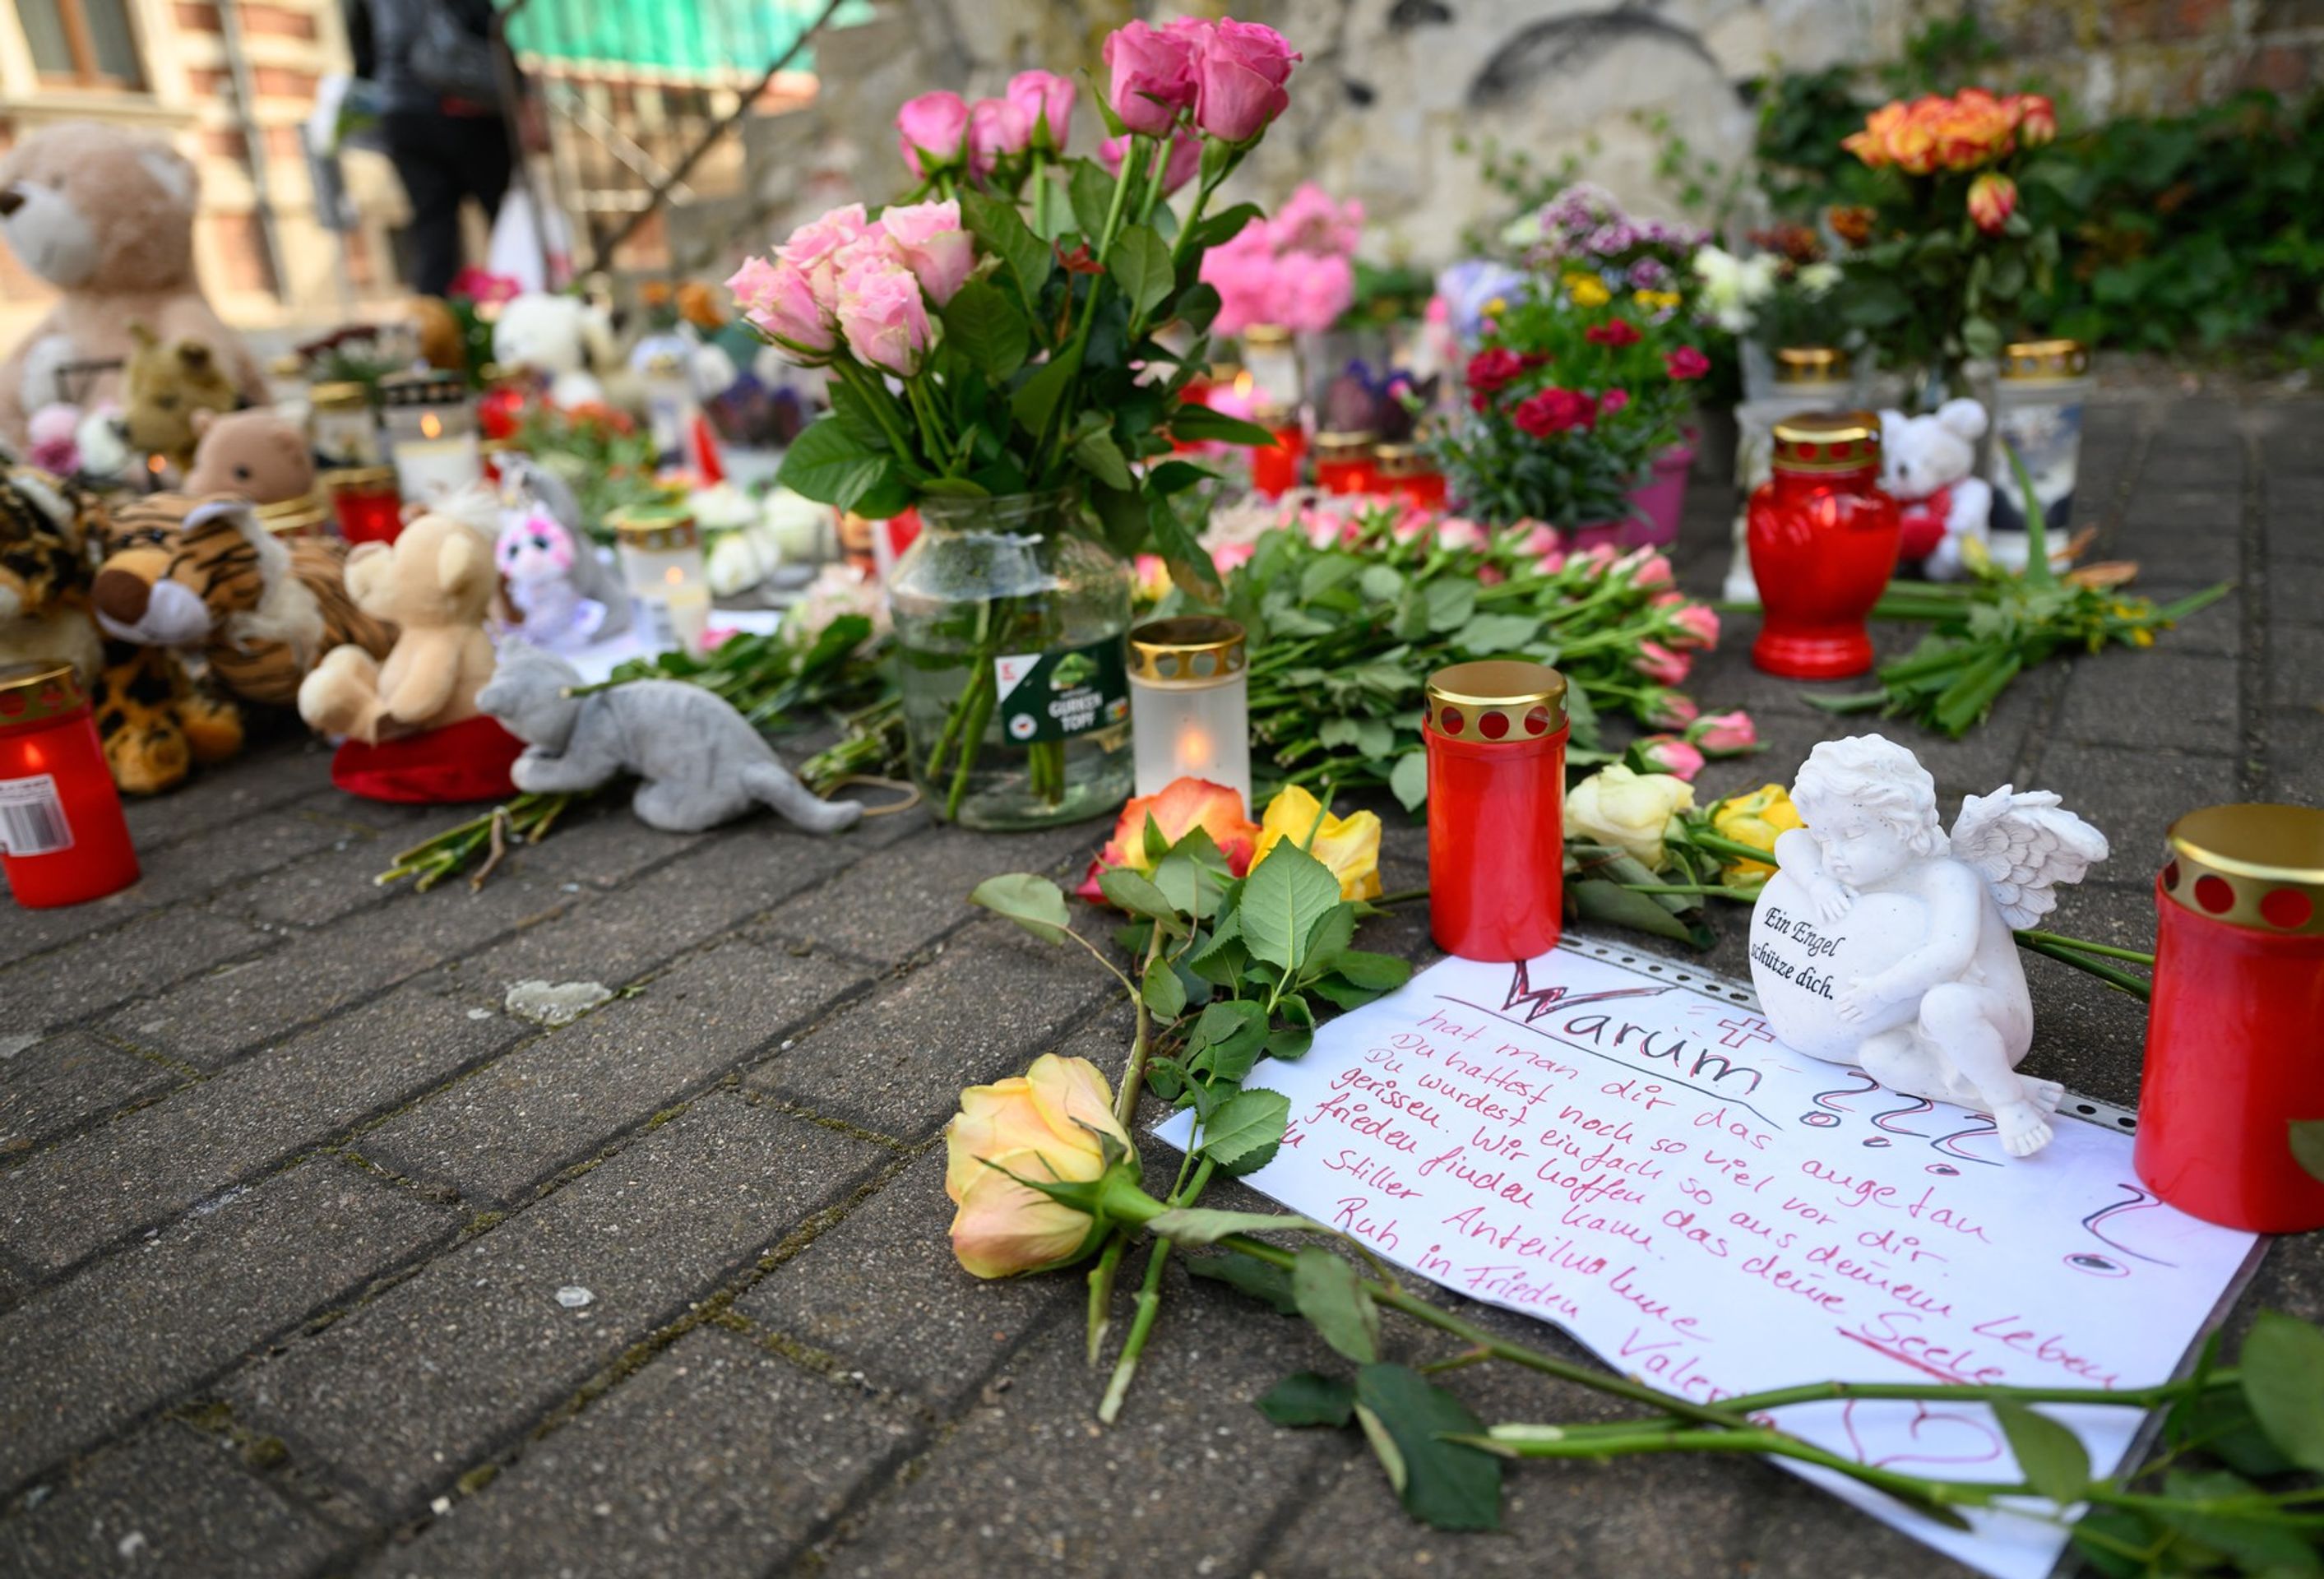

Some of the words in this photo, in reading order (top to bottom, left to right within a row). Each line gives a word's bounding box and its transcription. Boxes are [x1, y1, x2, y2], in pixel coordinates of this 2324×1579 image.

[1751, 942, 1794, 979] schütze
[1795, 966, 1834, 1001] dich.
[1764, 907, 1791, 934] Ein
[1791, 921, 1846, 957] Engel
[1390, 1033, 1435, 1058] Du
[1445, 1051, 1554, 1105] hattest
[1559, 1105, 1634, 1144] noch
[1650, 1138, 1687, 1154] so
[1704, 1150, 1775, 1192] viel
[1782, 1197, 1838, 1225] vor
[1416, 1009, 1487, 1042] hat
[1495, 1043, 1579, 1080] man
[1600, 1079, 1677, 1110] dir
[1693, 1107, 1773, 1150] das
[1364, 1048, 1405, 1074] Du
[1418, 1073, 1527, 1128] wurdest
[1679, 1178, 1713, 1205] so
[1729, 1212, 1798, 1248] aus
[1806, 1245, 1952, 1317] deinem
[1972, 1315, 2120, 1390] Leben
[1418, 1146, 1534, 1209] finden
[1333, 1197, 1399, 1251] Ruh
[1416, 1243, 1451, 1276] in
[1464, 1264, 1579, 1319] Frieden
[1471, 1126, 1530, 1160] Wir
[1536, 1158, 1646, 1204] hoffen
[1662, 1210, 1729, 1257] das
[1741, 1254, 1847, 1315] deine
[1860, 1312, 2005, 1386] Seele
